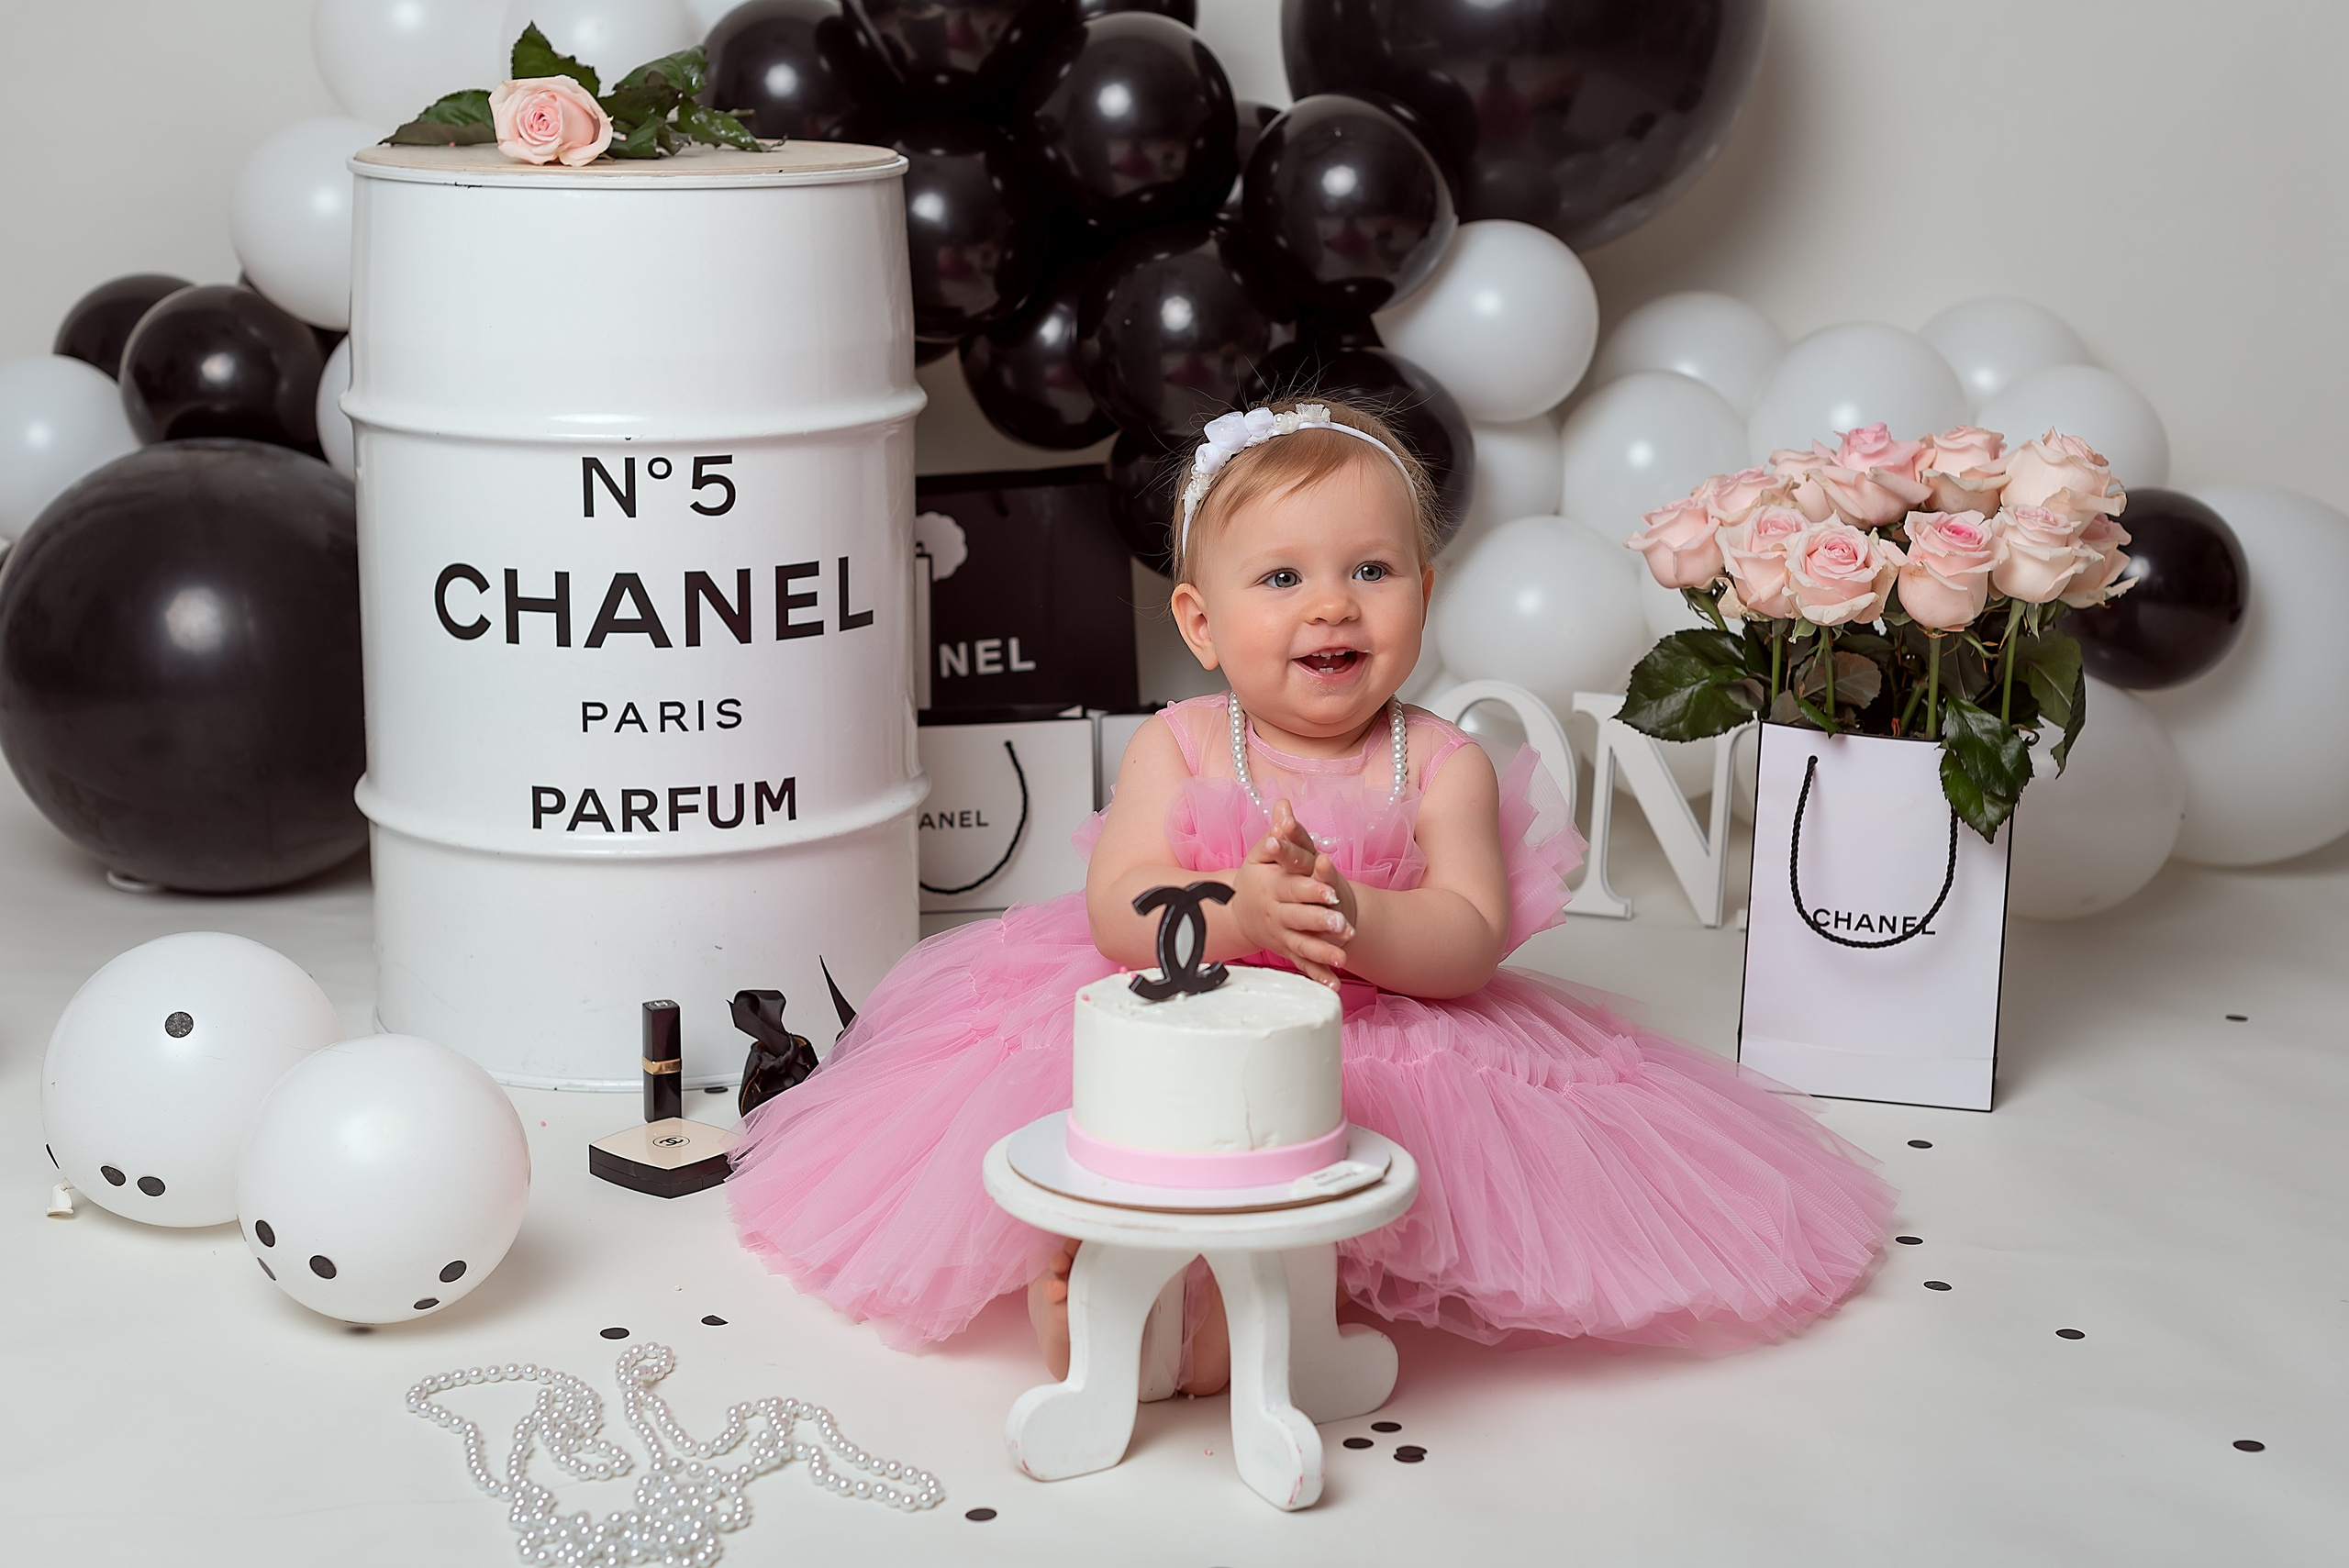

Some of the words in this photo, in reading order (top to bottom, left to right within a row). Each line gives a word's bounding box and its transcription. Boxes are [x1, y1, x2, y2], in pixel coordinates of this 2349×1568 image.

[434, 555, 874, 649] CHANEL
[581, 697, 743, 733] PARIS
[531, 776, 797, 833] PARFUM
[1812, 907, 1937, 936] CHANEL
